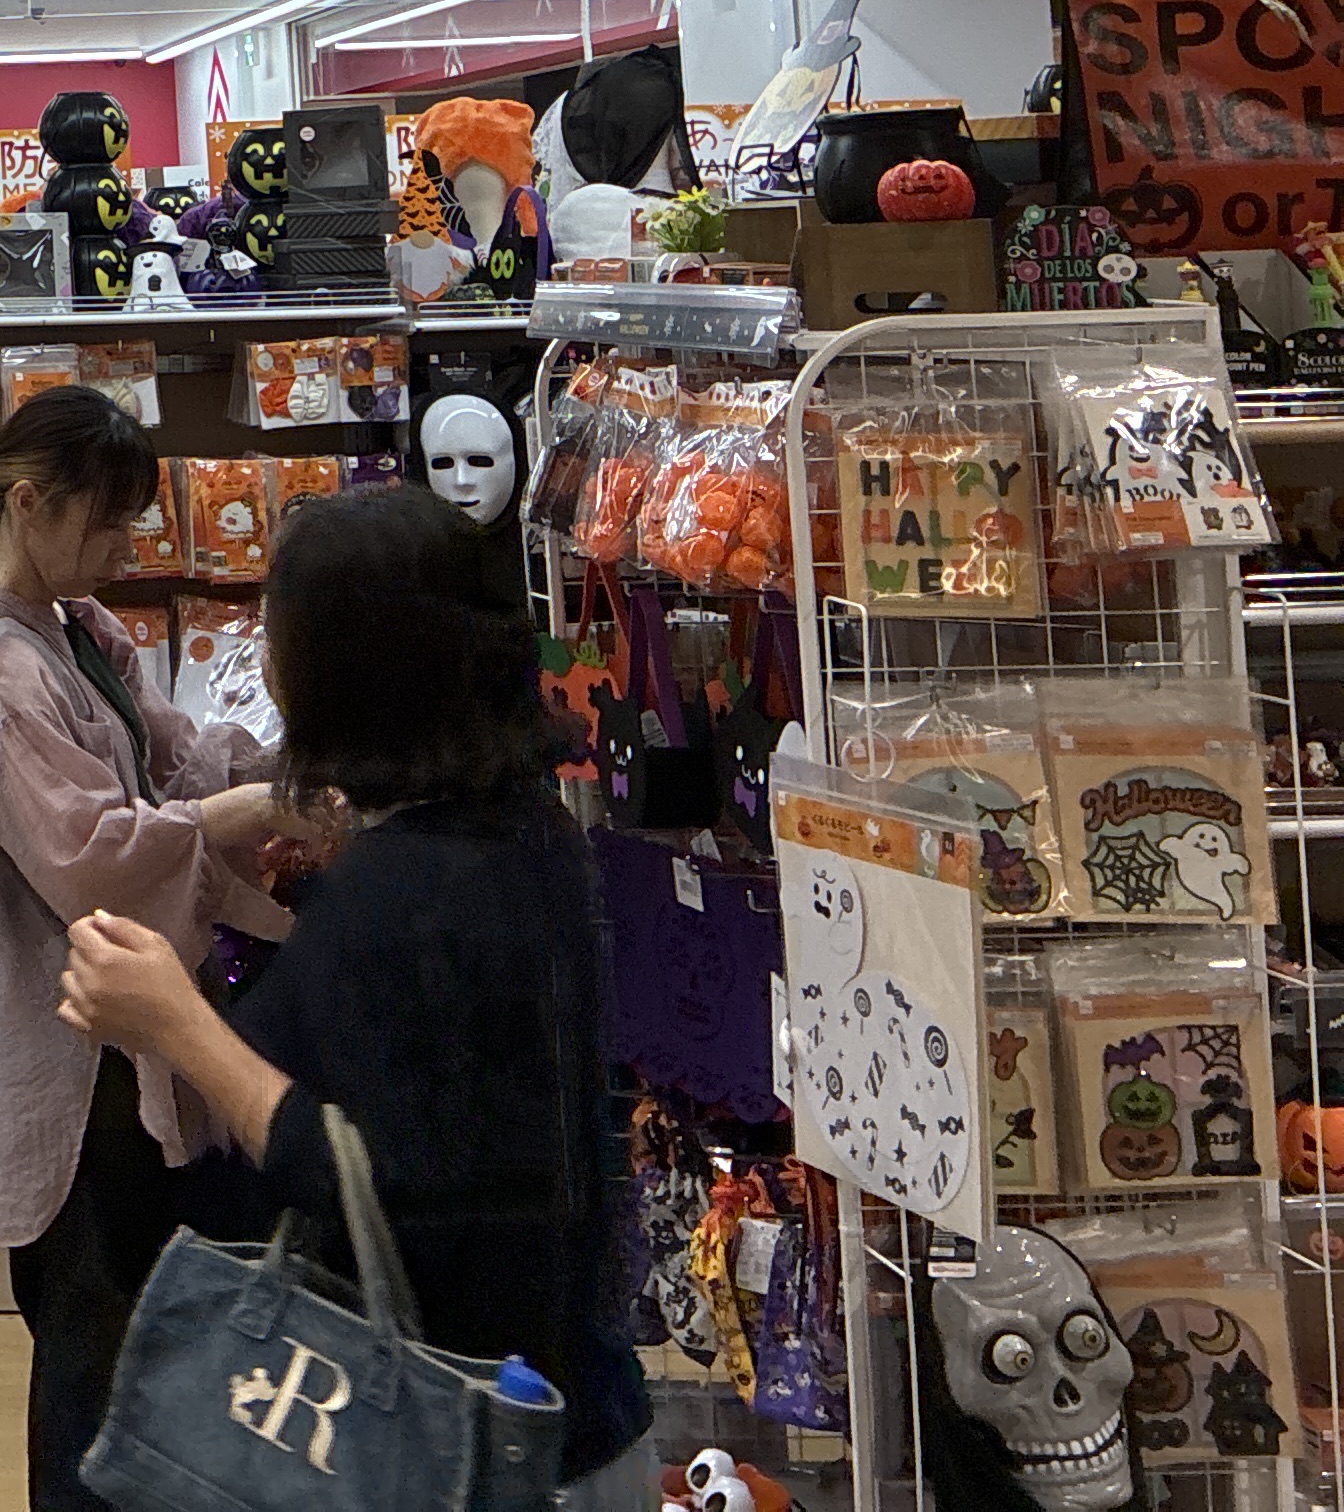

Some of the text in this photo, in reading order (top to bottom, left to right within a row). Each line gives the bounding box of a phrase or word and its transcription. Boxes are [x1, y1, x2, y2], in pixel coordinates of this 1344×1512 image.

[1081, 0, 1315, 75] SPO
[1, 139, 59, 179] 防
[1221, 190, 1305, 238] or
[1039, 218, 1094, 257] DÍA
[1044, 259, 1093, 278] DE LOS
[1007, 282, 1135, 311] MUERTOS
[860, 452, 1021, 498] HAPPY
[1080, 778, 1242, 832] Halloween
[258, 1337, 354, 1474] R
